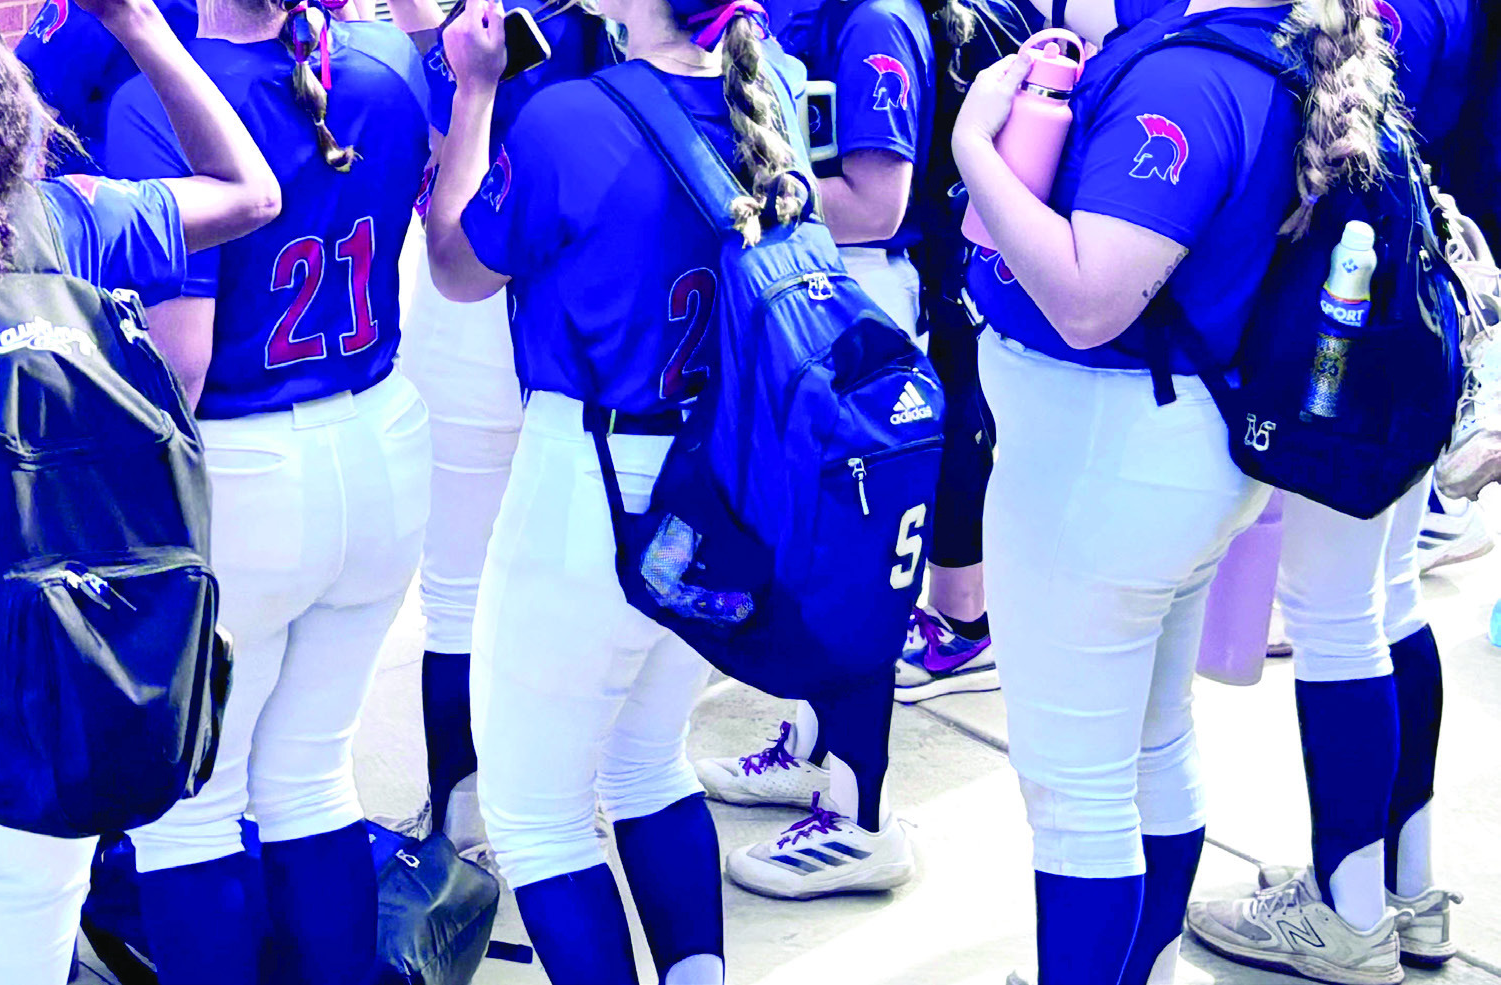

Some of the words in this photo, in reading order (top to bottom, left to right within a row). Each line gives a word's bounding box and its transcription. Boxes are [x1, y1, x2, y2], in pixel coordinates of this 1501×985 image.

[265, 216, 378, 369] 21
[1320, 300, 1365, 323] SPORT
[890, 405, 932, 425] adidas
[889, 503, 926, 579] S
